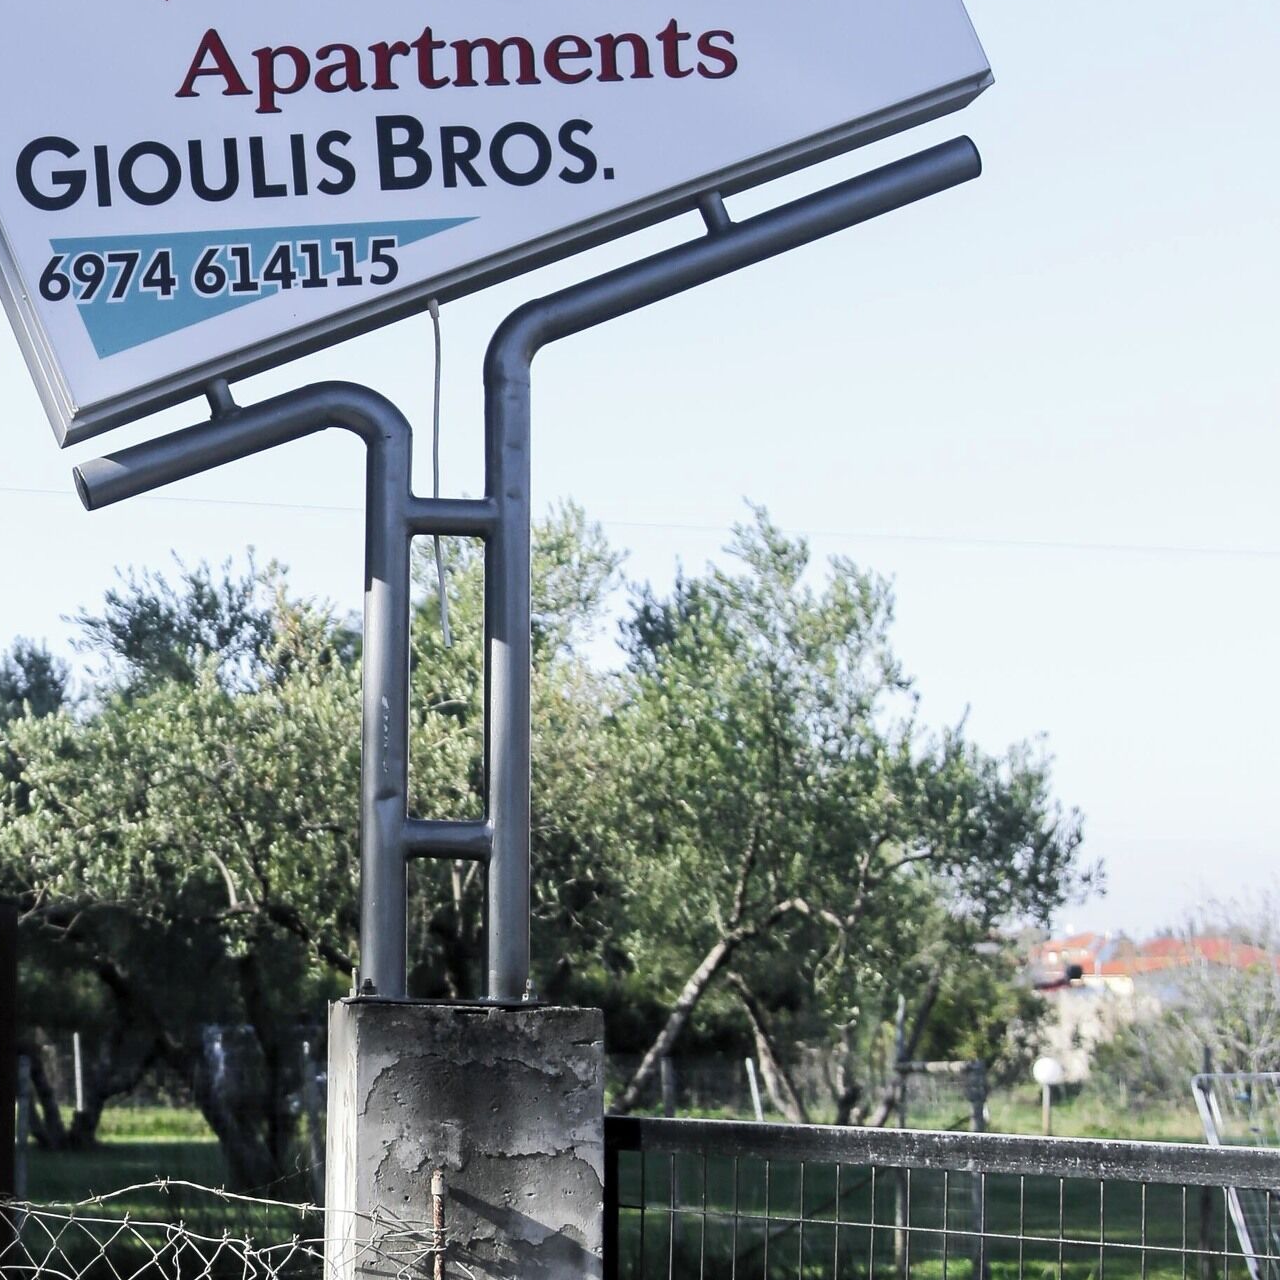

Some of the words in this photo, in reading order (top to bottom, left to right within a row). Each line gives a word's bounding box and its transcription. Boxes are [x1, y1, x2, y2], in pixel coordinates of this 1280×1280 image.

[173, 17, 739, 115] Apartments
[14, 129, 357, 212] GIOULIS
[374, 113, 616, 192] BROS.
[36, 249, 177, 303] 6974
[192, 237, 400, 295] 614115
